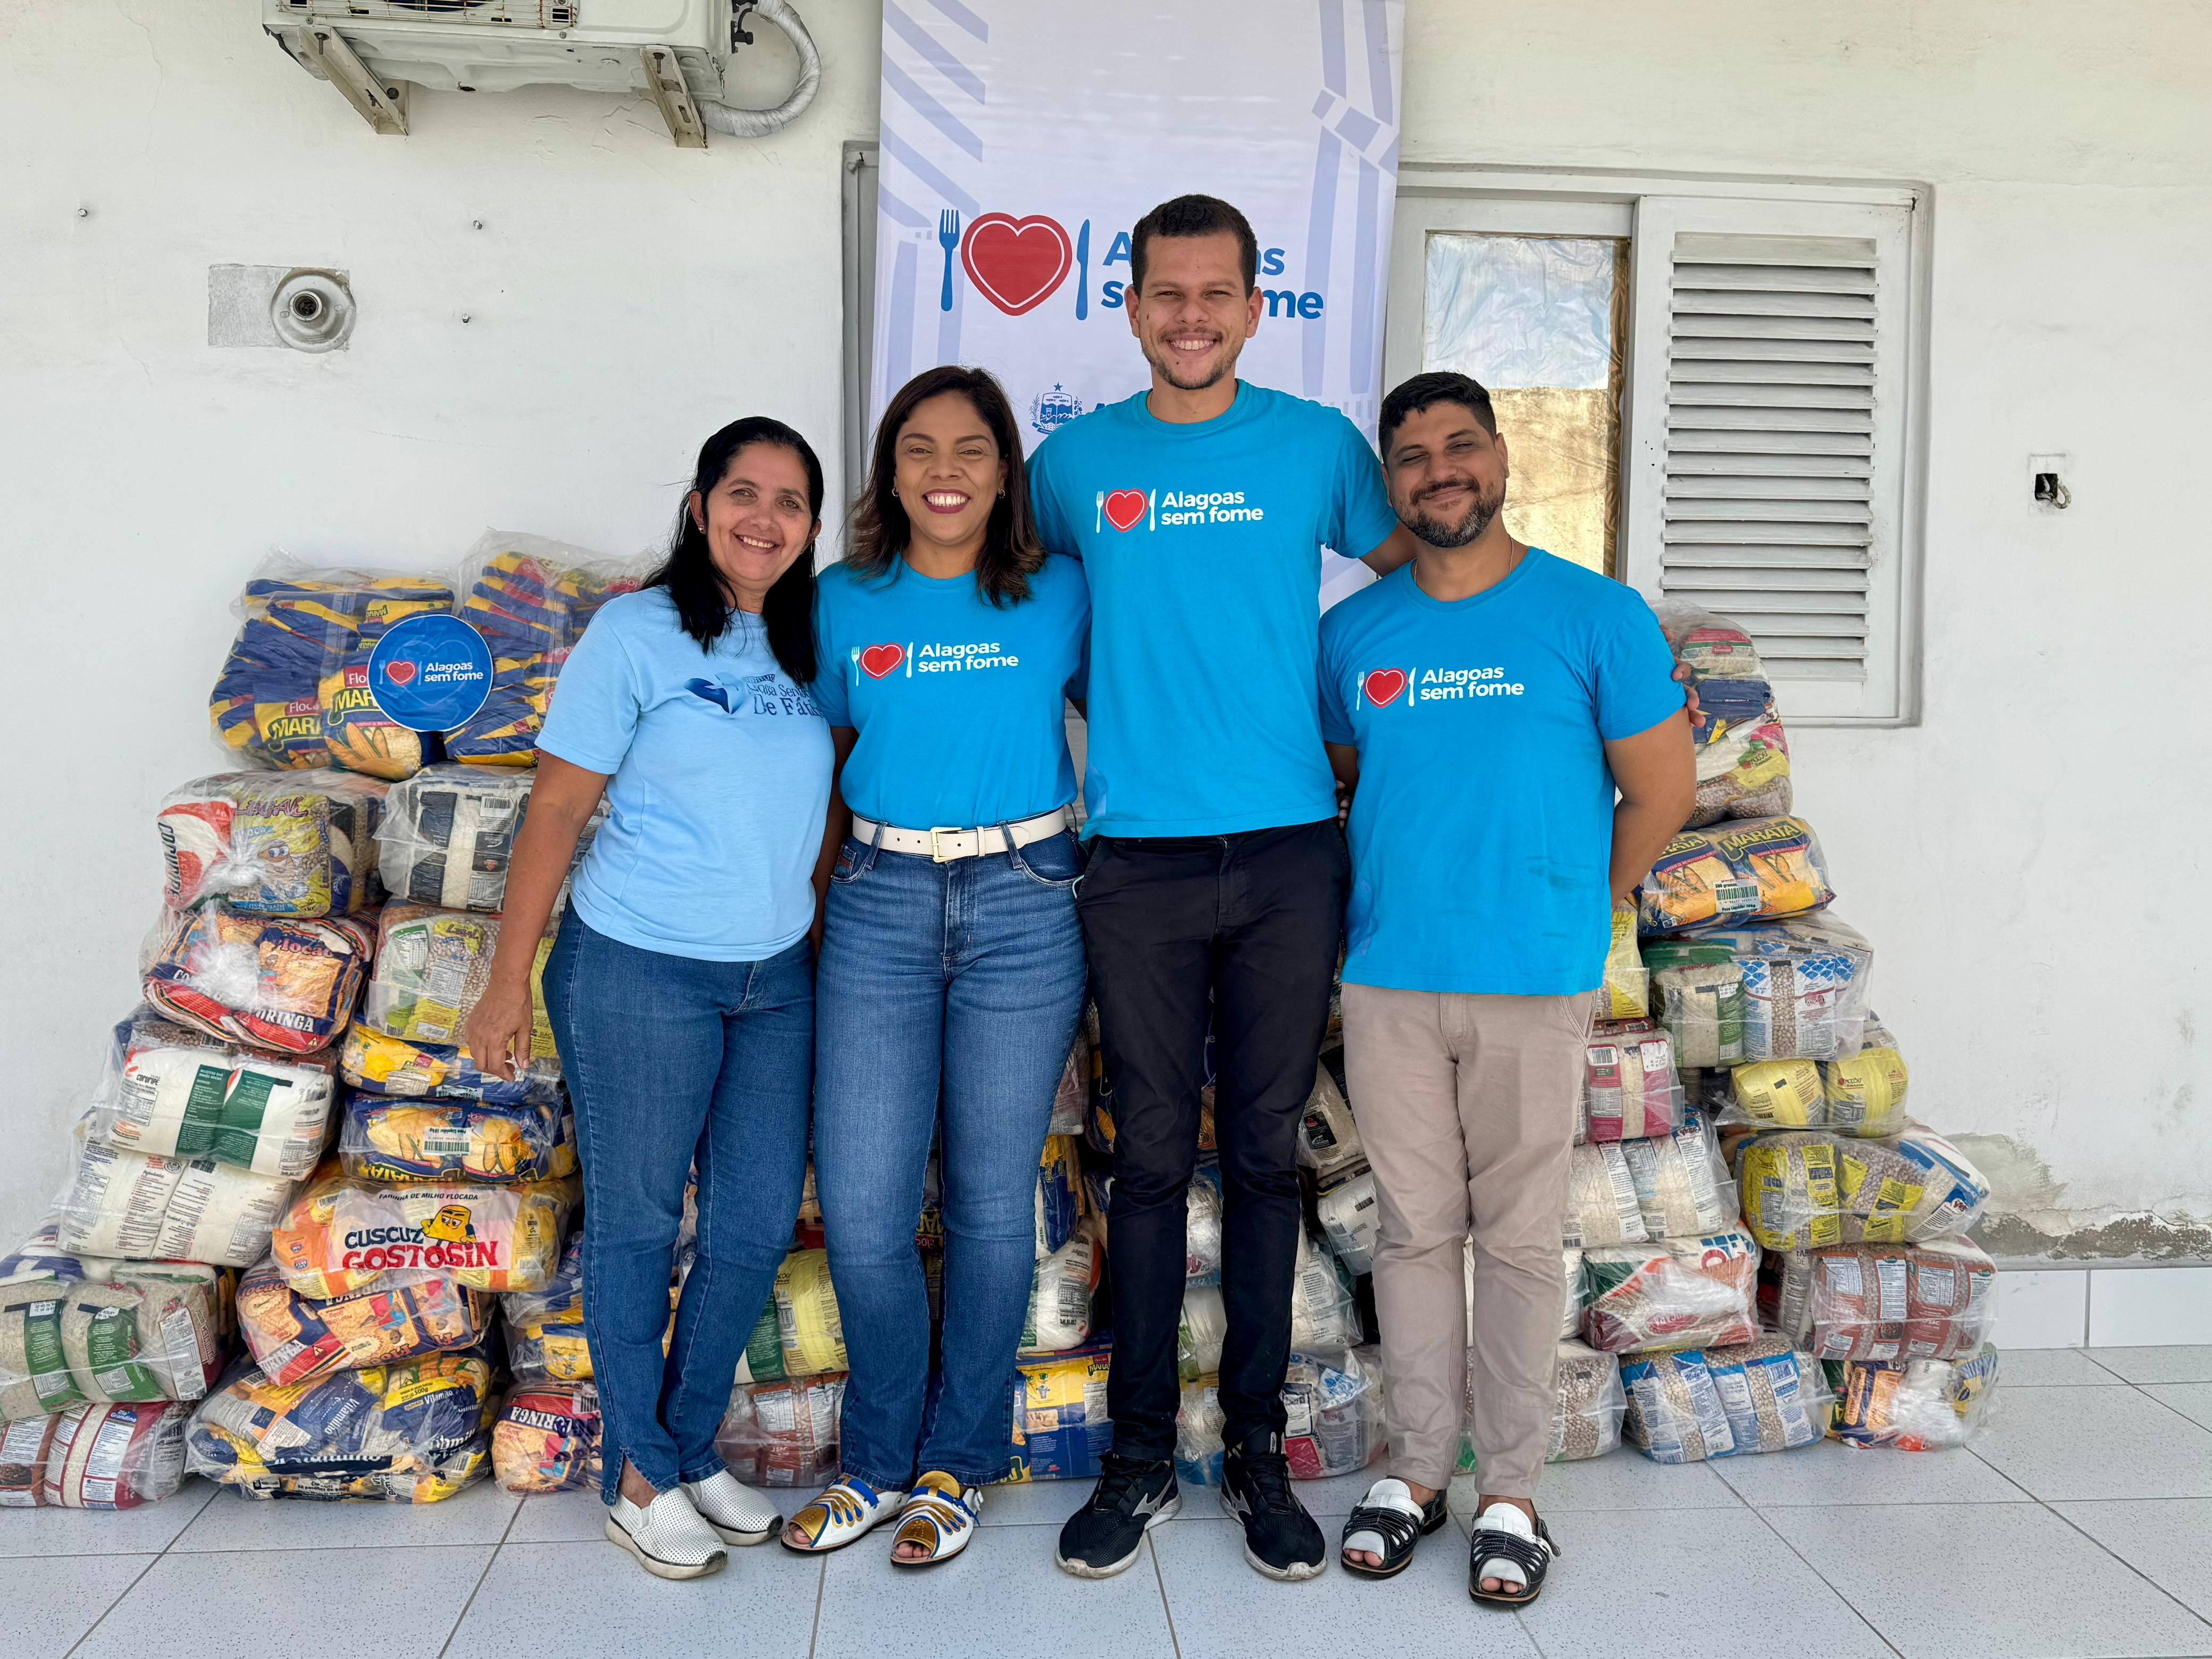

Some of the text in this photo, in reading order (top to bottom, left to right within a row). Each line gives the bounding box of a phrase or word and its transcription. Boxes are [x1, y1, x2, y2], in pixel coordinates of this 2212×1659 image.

[1262, 289, 1324, 320] me
[1161, 491, 1245, 510] Alagoas
[1161, 506, 1264, 525] sem fome
[918, 642, 1000, 659] Alagoas
[425, 661, 473, 674] Alagoas
[918, 655, 1019, 673] sem fome
[349, 672, 368, 685] Flo
[424, 668, 484, 683] sem fome
[1420, 667, 1504, 685] Alagoas
[1420, 681, 1524, 700] sem fome
[335, 689, 377, 713] MAR
[754, 694, 777, 716] De
[255, 1010, 315, 1033] ORINGA
[379, 1193, 408, 1202] FARINHA
[345, 1226, 424, 1249] CUSCUZ
[414, 1387, 429, 1396] 500g
[110, 1412, 137, 1423] Grandino
